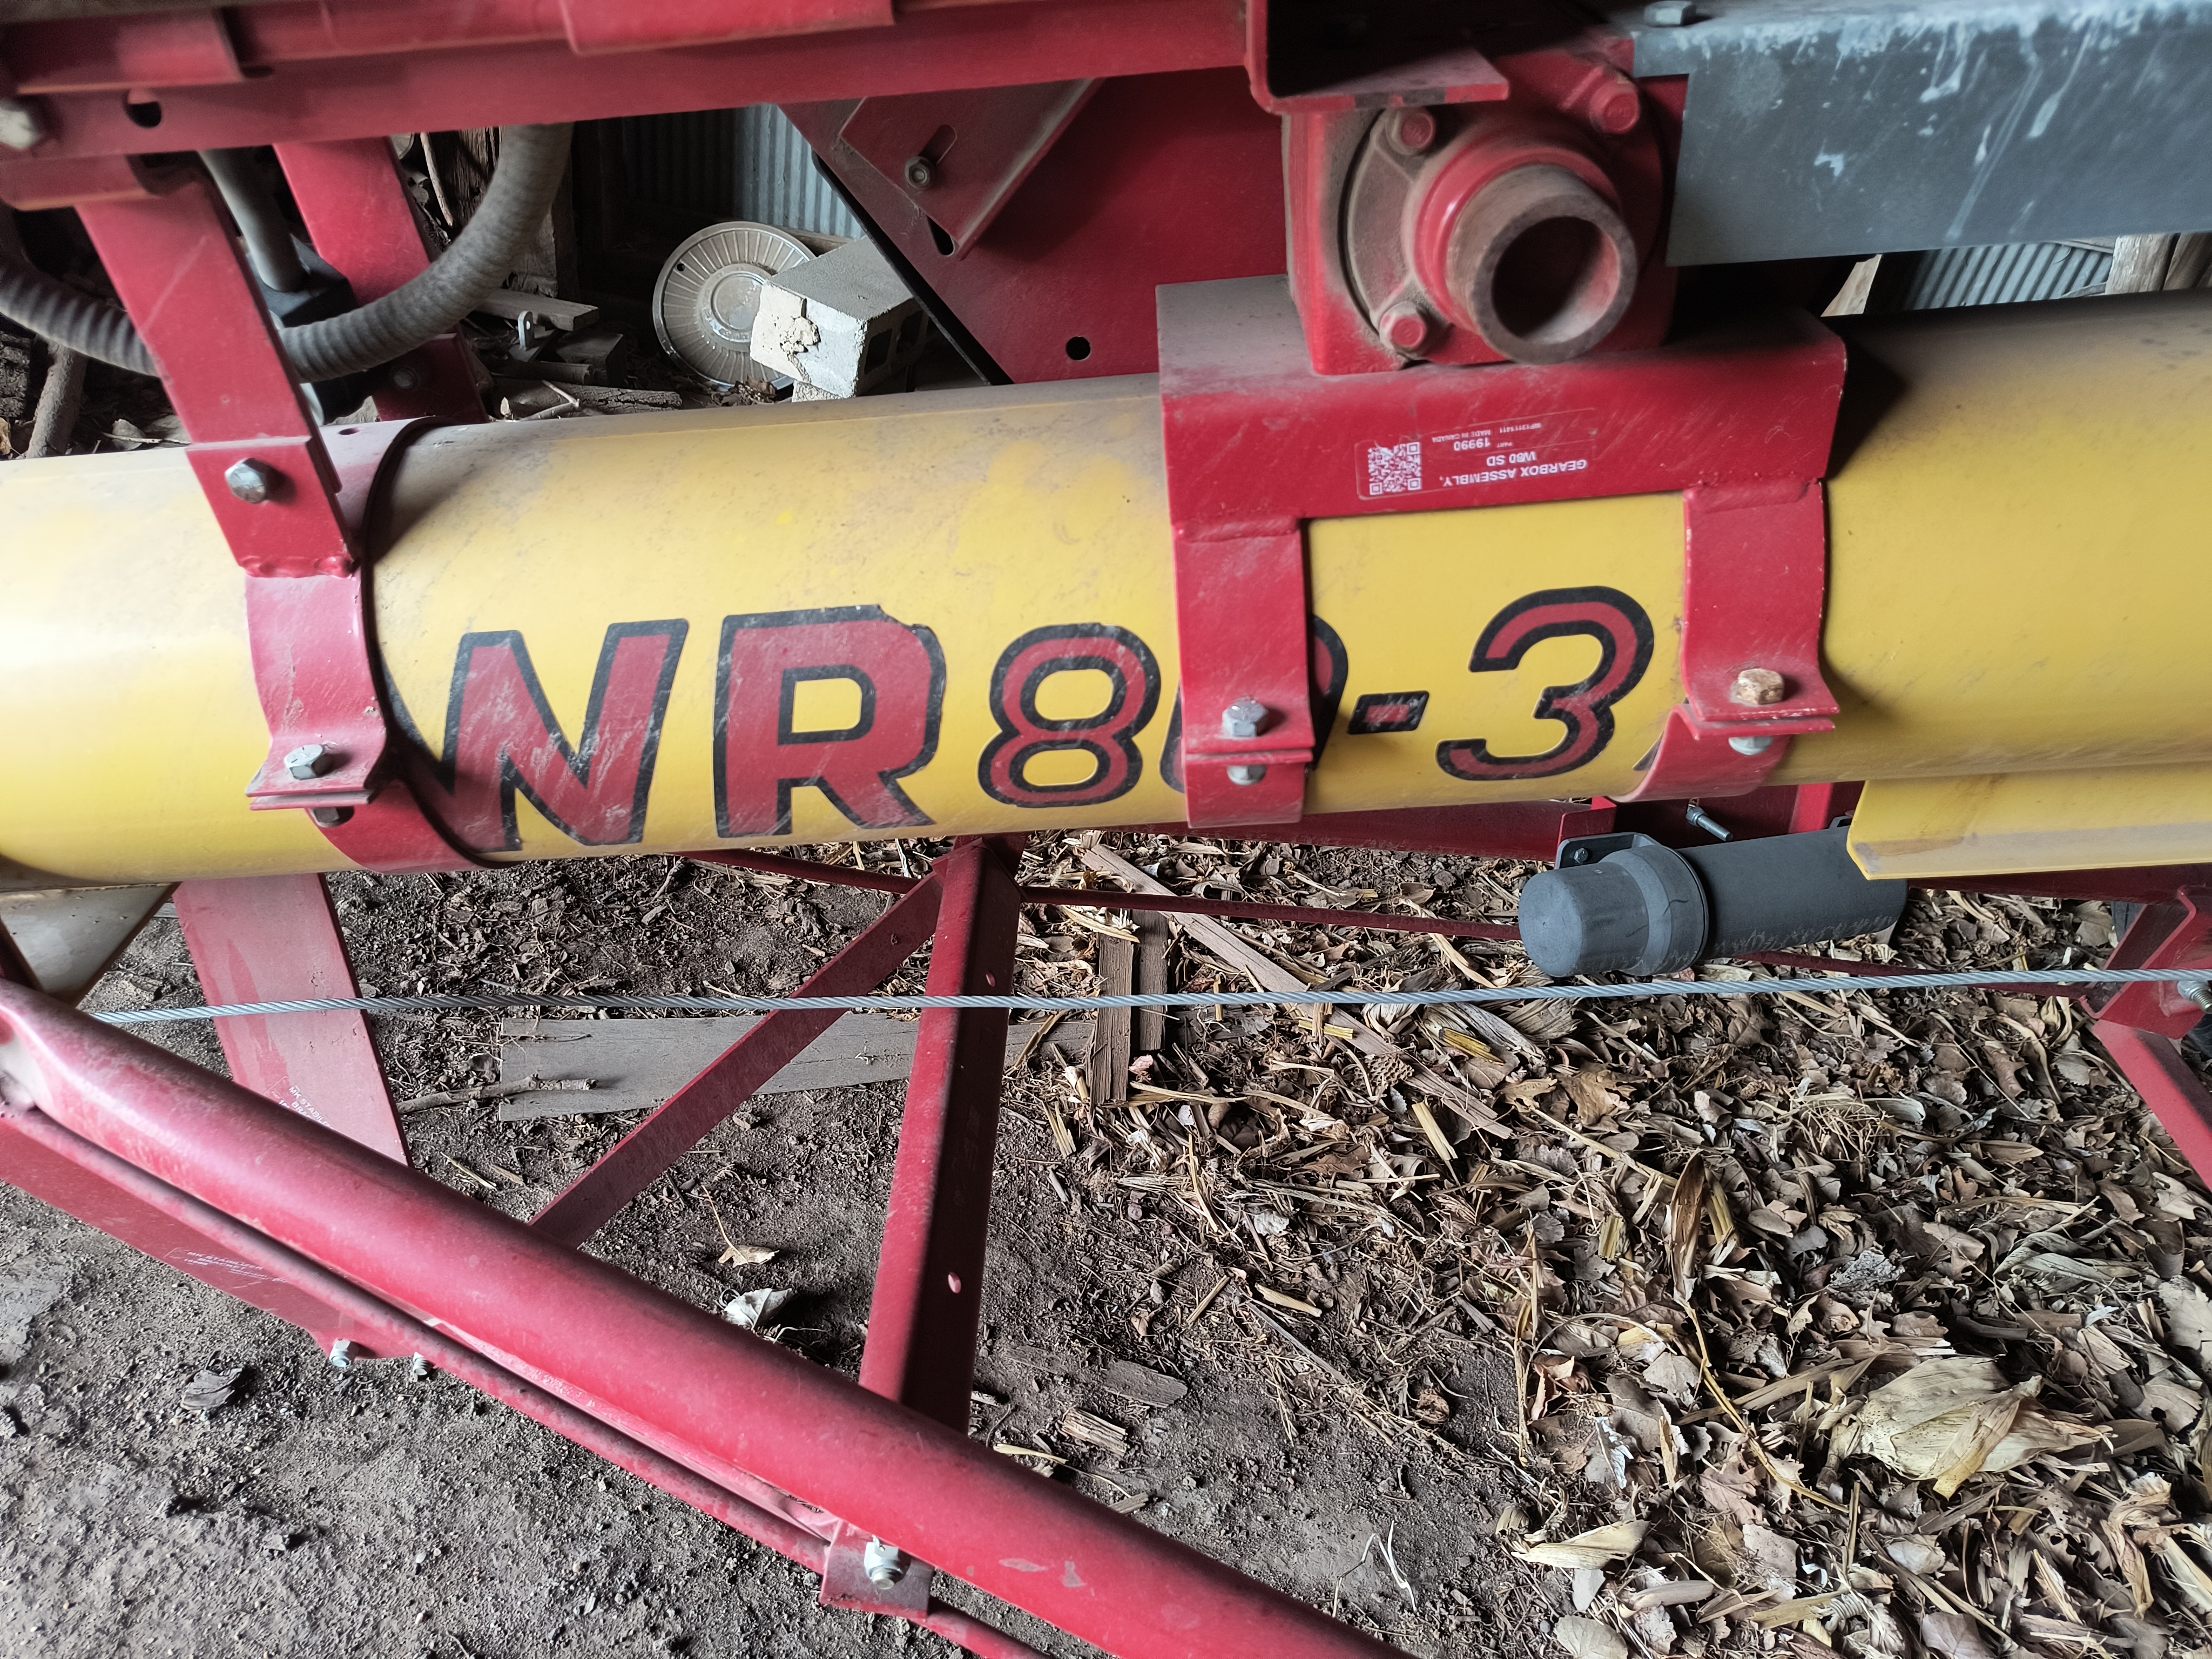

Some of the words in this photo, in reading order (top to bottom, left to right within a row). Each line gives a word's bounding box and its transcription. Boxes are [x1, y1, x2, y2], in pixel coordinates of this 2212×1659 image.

[1432, 434, 1460, 443] CANADA
[1454, 437, 1491, 451] 19990
[1486, 455, 1506, 466] SD
[1520, 459, 1588, 477] GEARBOX
[1439, 468, 1516, 487] ASSEMBLY,
[289, 1087, 302, 1099] MK
